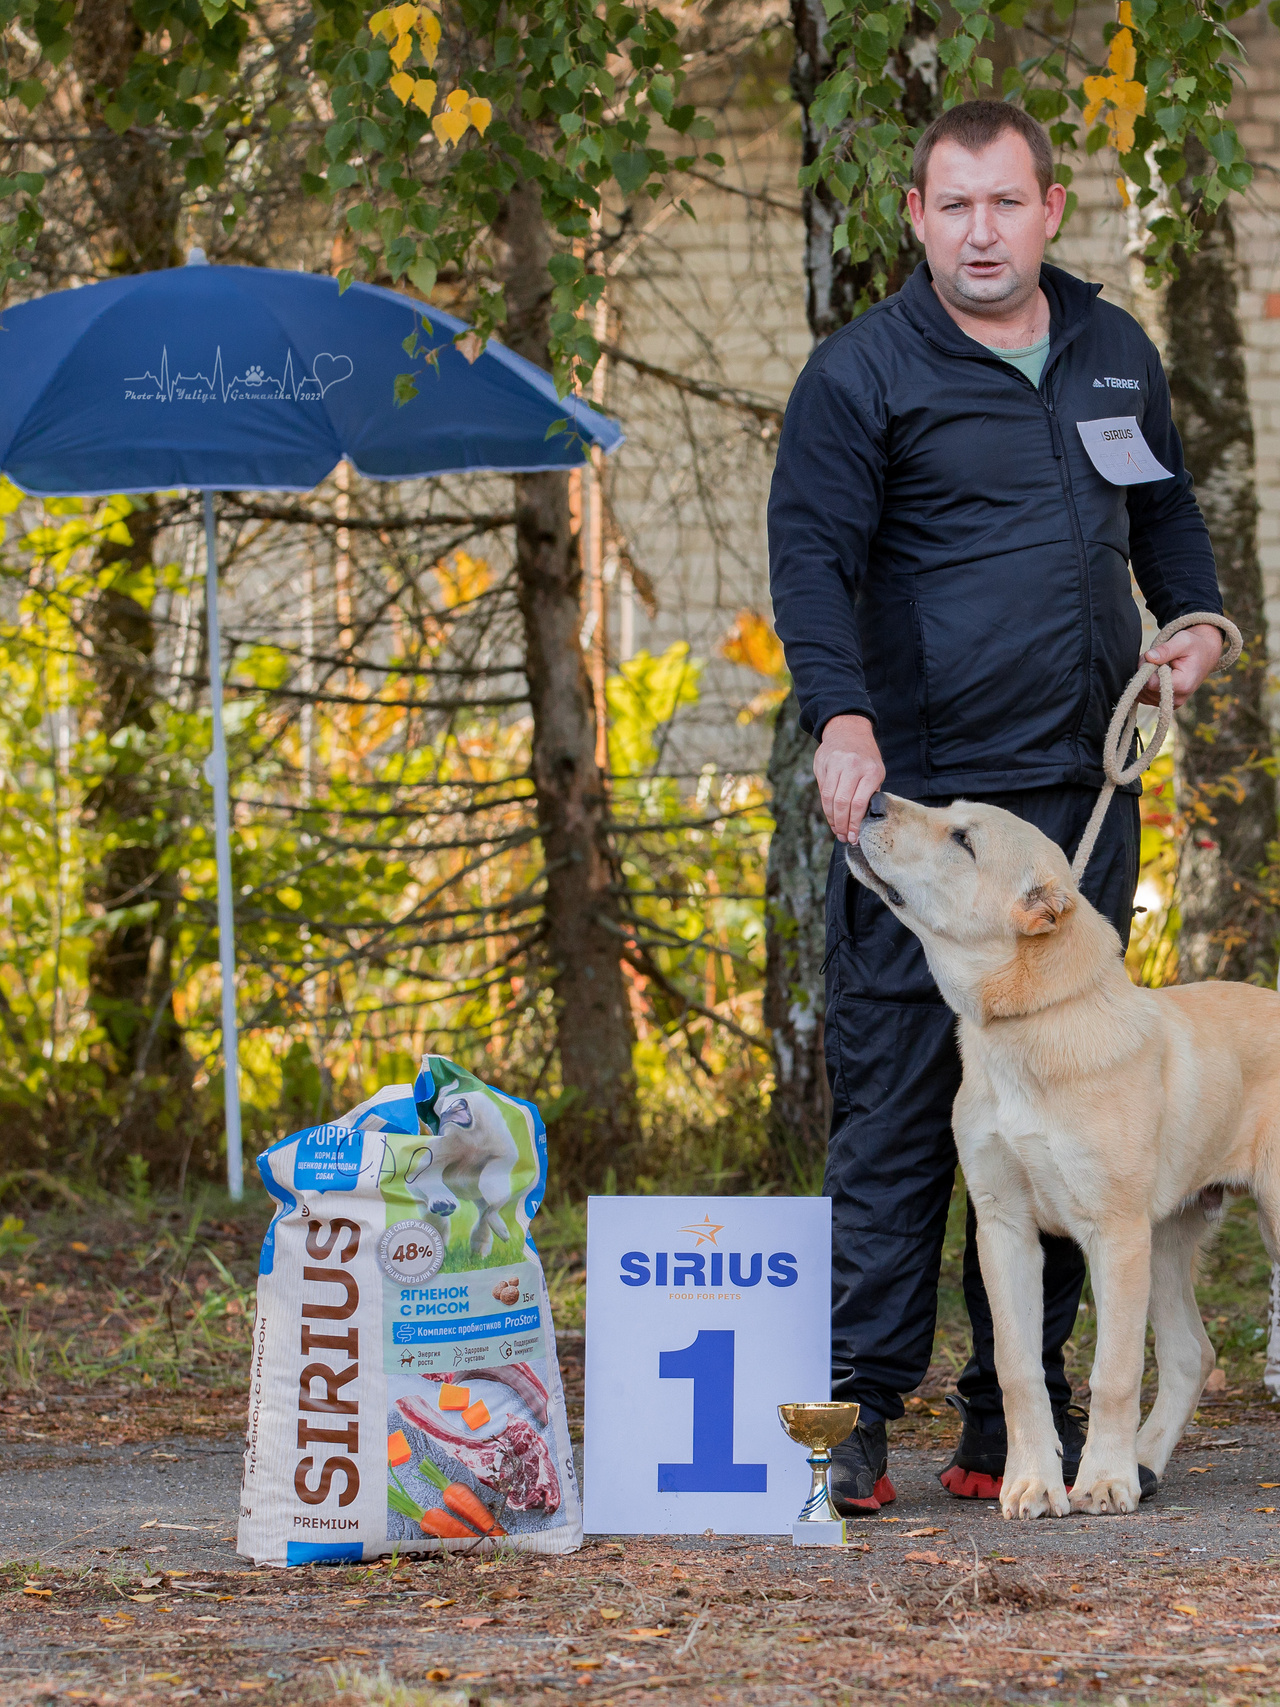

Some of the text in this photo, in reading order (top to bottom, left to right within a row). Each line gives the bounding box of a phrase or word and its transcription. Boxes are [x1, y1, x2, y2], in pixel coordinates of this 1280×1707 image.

[1103, 376, 1141, 391] TERREX
[1103, 428, 1134, 441] SIRIUS
[306, 1126, 358, 1147] PUPPY
[314, 1151, 331, 1160] КОРМ
[297, 1161, 322, 1171] ЩЕНКОВ
[327, 1161, 358, 1171] МОЛОДЫХ
[315, 1172, 335, 1181] СОБАК
[393, 1220, 437, 1237] СОДЕРЖАНИЕ
[392, 1242, 433, 1263] 48%
[619, 1251, 799, 1288] SIRIUS
[400, 1285, 469, 1301] ЯГНЕНОК
[669, 1293, 742, 1301] FOOD FOR PETS
[400, 1300, 470, 1316] С РИСОМ
[417, 1314, 538, 1337] Комплекс пробиотиков ProStor+
[256, 1317, 267, 1378] РИСОМ
[417, 1350, 441, 1359] Энергия
[464, 1345, 490, 1355] Здоровые
[294, 1217, 362, 1508] SIRIUS
[417, 1359, 434, 1367] роста
[464, 1354, 486, 1363] суставы
[657, 1329, 768, 1493] 1
[293, 1516, 360, 1530] PREMIUM
